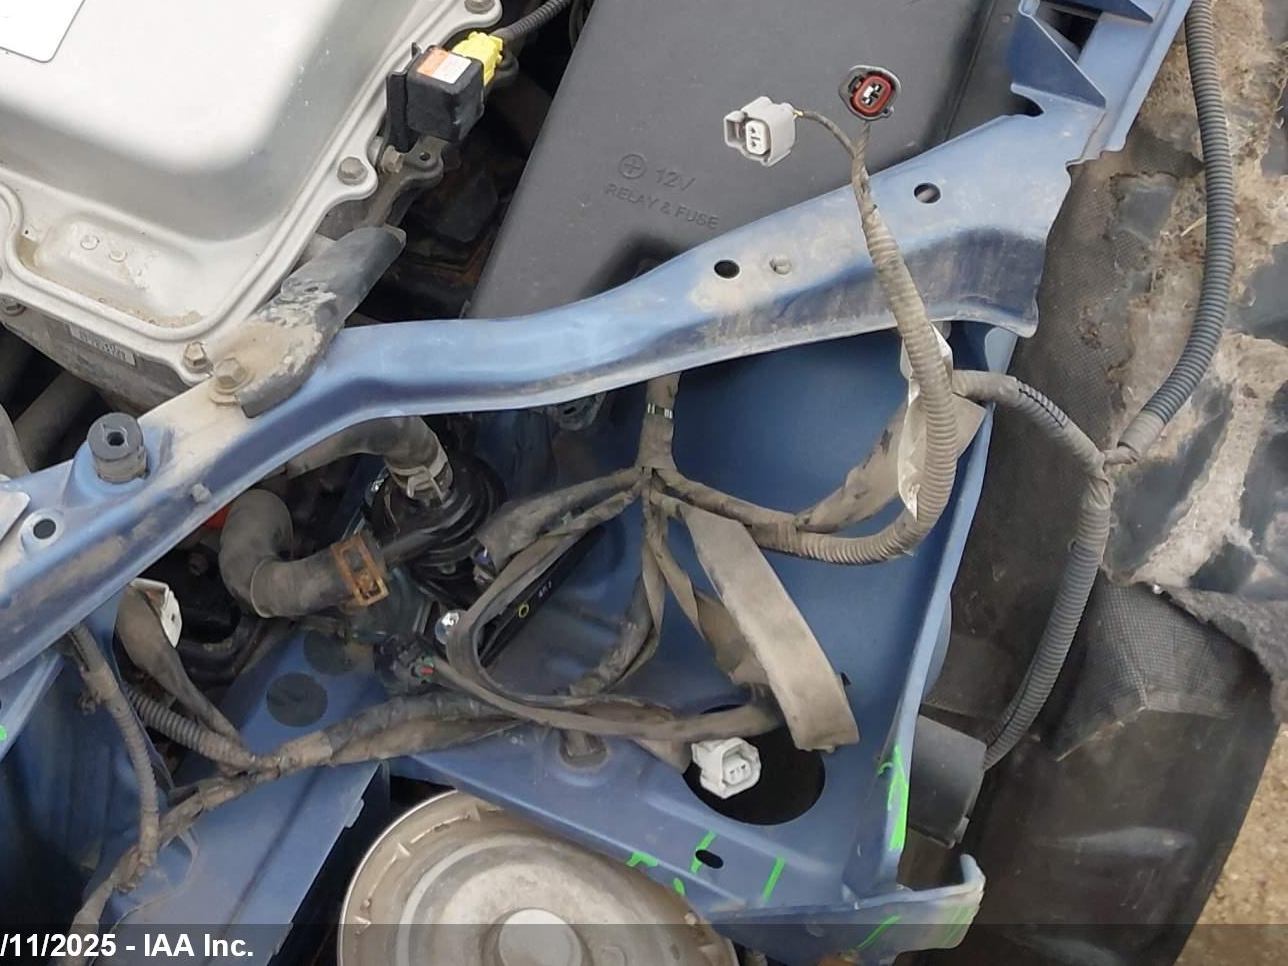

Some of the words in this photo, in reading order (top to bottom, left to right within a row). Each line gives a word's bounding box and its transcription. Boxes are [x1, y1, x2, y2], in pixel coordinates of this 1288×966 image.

[606, 183, 660, 209] RELAY
[660, 200, 671, 215] &
[674, 204, 720, 230] FUSE
